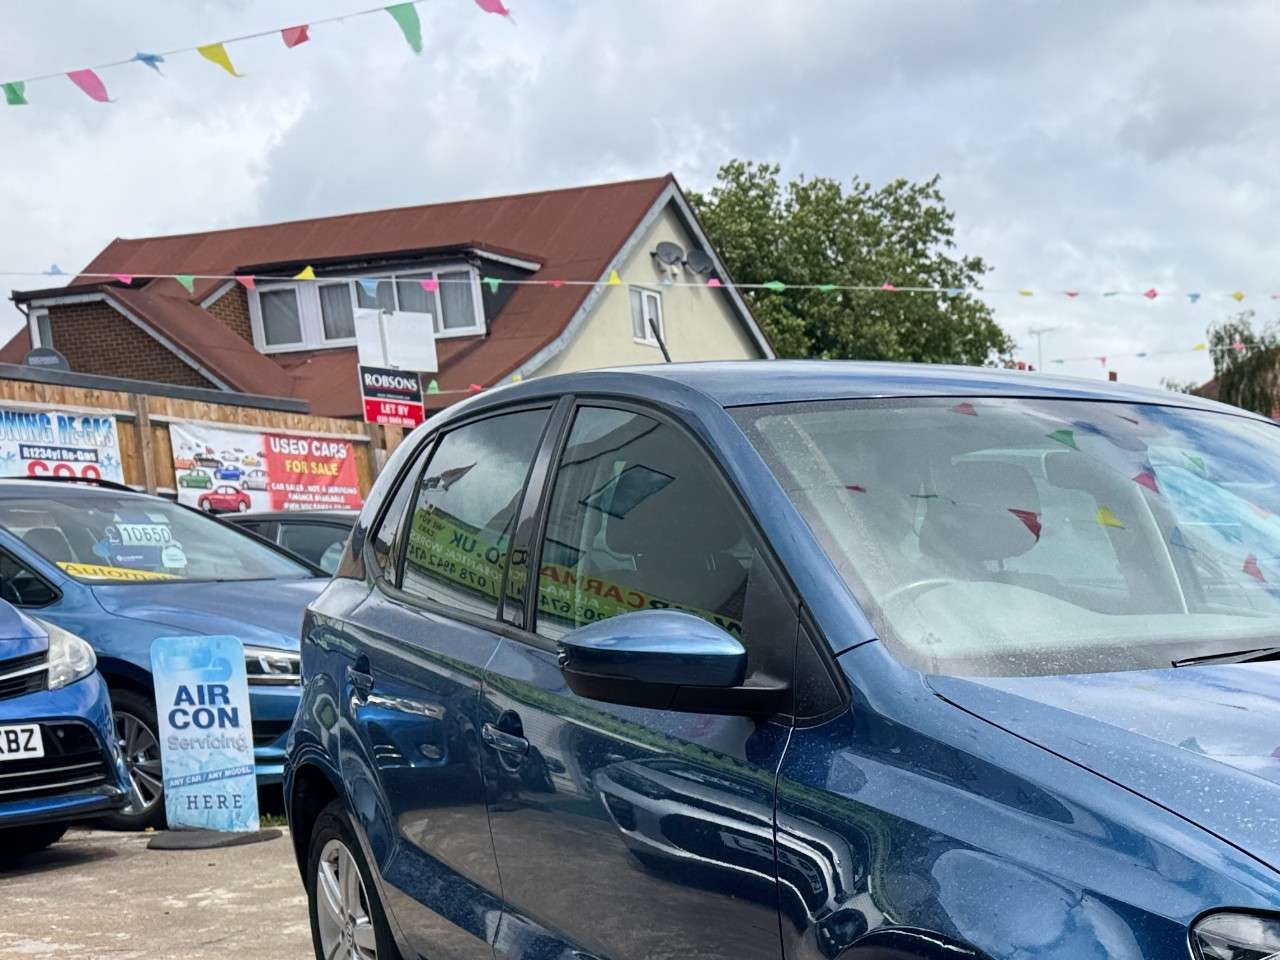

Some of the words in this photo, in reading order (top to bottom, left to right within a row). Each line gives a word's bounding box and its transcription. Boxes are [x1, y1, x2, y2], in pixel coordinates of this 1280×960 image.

[364, 372, 418, 391] ROBSONS
[381, 402, 396, 414] LET
[397, 405, 409, 417] BY
[0, 410, 53, 442] NING
[270, 437, 308, 456] USED
[311, 440, 347, 459] CARS
[285, 459, 308, 474] FOR
[311, 462, 339, 477] SALE
[173, 684, 231, 706] AIR
[168, 707, 240, 730] CON
[0, 728, 37, 754] BZ
[167, 733, 249, 752] Servicing
[170, 776, 184, 788] ANY
[186, 774, 202, 785] CAR
[207, 769, 223, 781] ANY
[224, 764, 252, 778] MODEL
[186, 794, 243, 810] HERE
